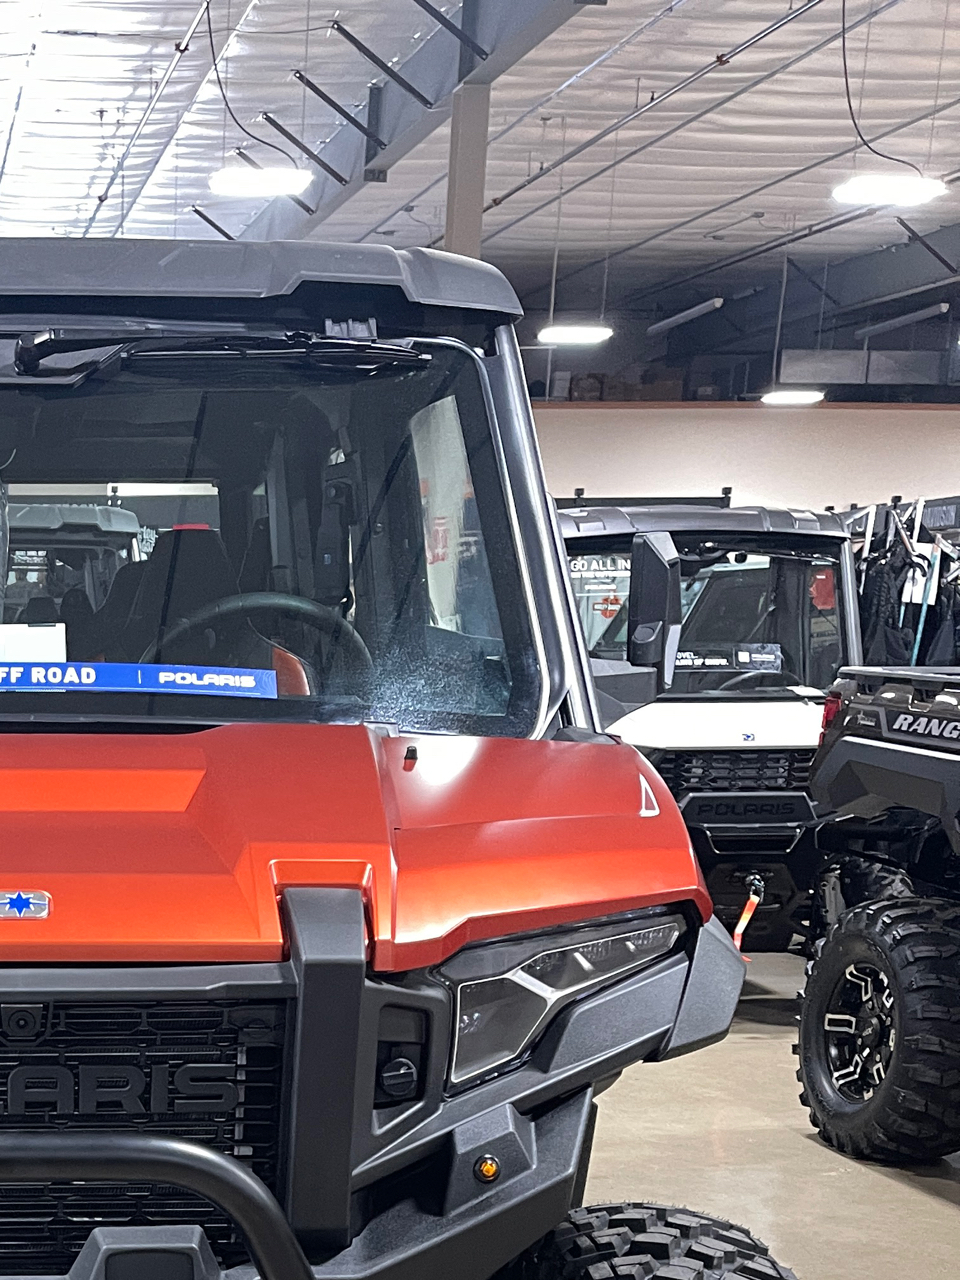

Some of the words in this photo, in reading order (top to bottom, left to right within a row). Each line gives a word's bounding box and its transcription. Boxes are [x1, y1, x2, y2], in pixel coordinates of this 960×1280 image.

[570, 560, 588, 571] GO
[590, 560, 616, 571] ALL
[617, 558, 631, 570] IN
[31, 666, 96, 684] ROAD
[158, 672, 256, 688] POLARIS
[698, 802, 795, 816] POLARIS
